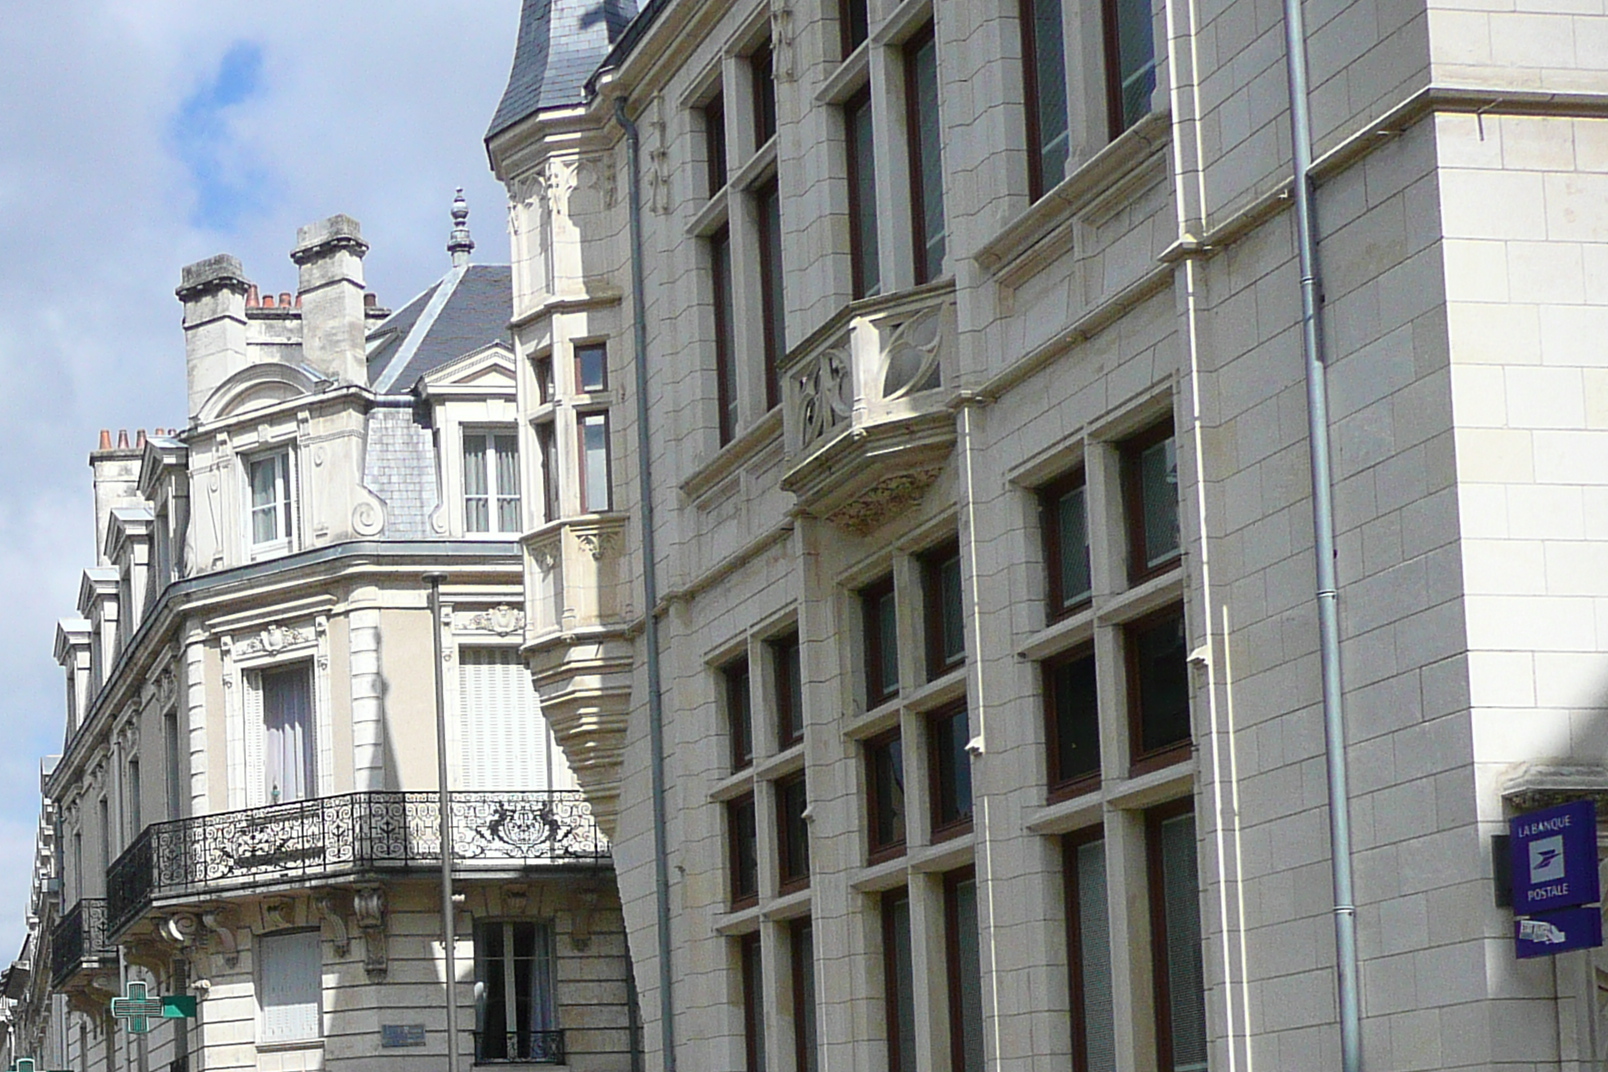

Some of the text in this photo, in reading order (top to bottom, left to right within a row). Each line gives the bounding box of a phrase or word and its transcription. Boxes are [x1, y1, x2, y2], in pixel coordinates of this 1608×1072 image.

[1518, 815, 1571, 838] LA BANQUE
[1527, 883, 1569, 901] POSTALE
